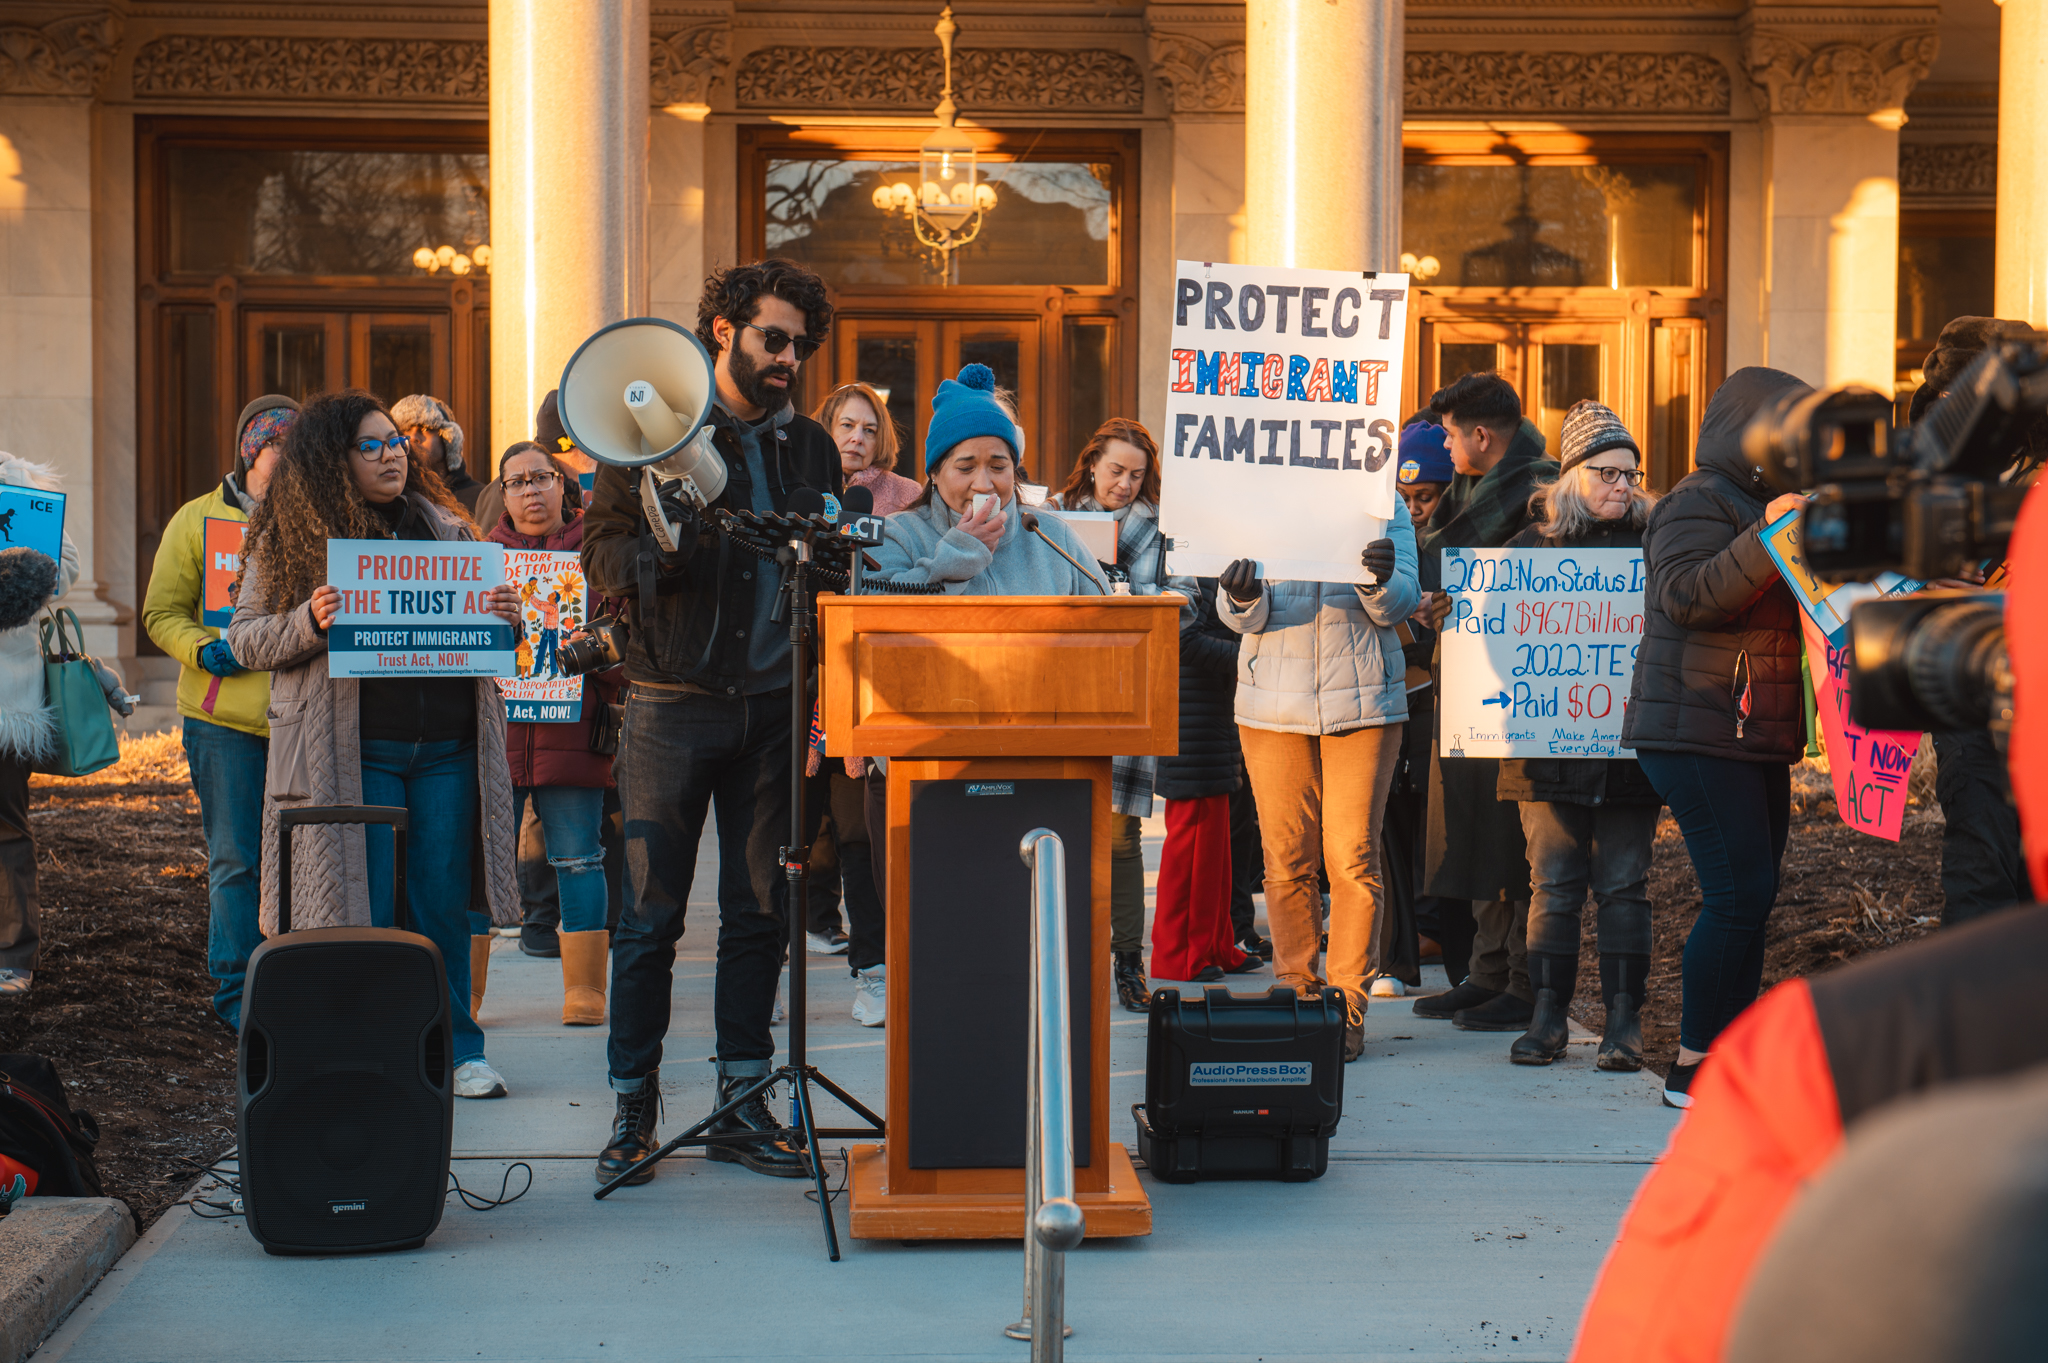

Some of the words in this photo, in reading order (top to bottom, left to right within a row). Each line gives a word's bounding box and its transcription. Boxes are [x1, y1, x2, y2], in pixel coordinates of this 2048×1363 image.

[1176, 278, 1405, 340] PROTECT
[1171, 348, 1389, 405] IMMIGRANT
[1173, 413, 1395, 473] FAMILIES
[30, 499, 53, 513] ICE
[855, 517, 882, 540] CT
[358, 554, 482, 581] PRIORITIZE
[514, 552, 553, 563] MORE
[342, 590, 381, 614] THE
[388, 590, 456, 614] TRUST
[1456, 599, 1506, 635] Paid
[354, 631, 410, 646] PROTECT
[412, 631, 492, 646] IMMIGRANTS
[377, 652, 408, 667] Trust
[411, 652, 431, 668] Act,
[438, 652, 469, 666] NOW!
[519, 674, 582, 690] DEPORTATIONS
[500, 688, 535, 699] OLISH
[1513, 681, 1558, 718] Paid
[1567, 682, 1611, 723] $0
[513, 705, 537, 720] Act,
[541, 705, 571, 719] NOW!
[1468, 726, 1536, 743] Immigrants
[1552, 728, 1585, 741] Make
[1848, 770, 1894, 827] ACT
[332, 1202, 365, 1213] gemini
